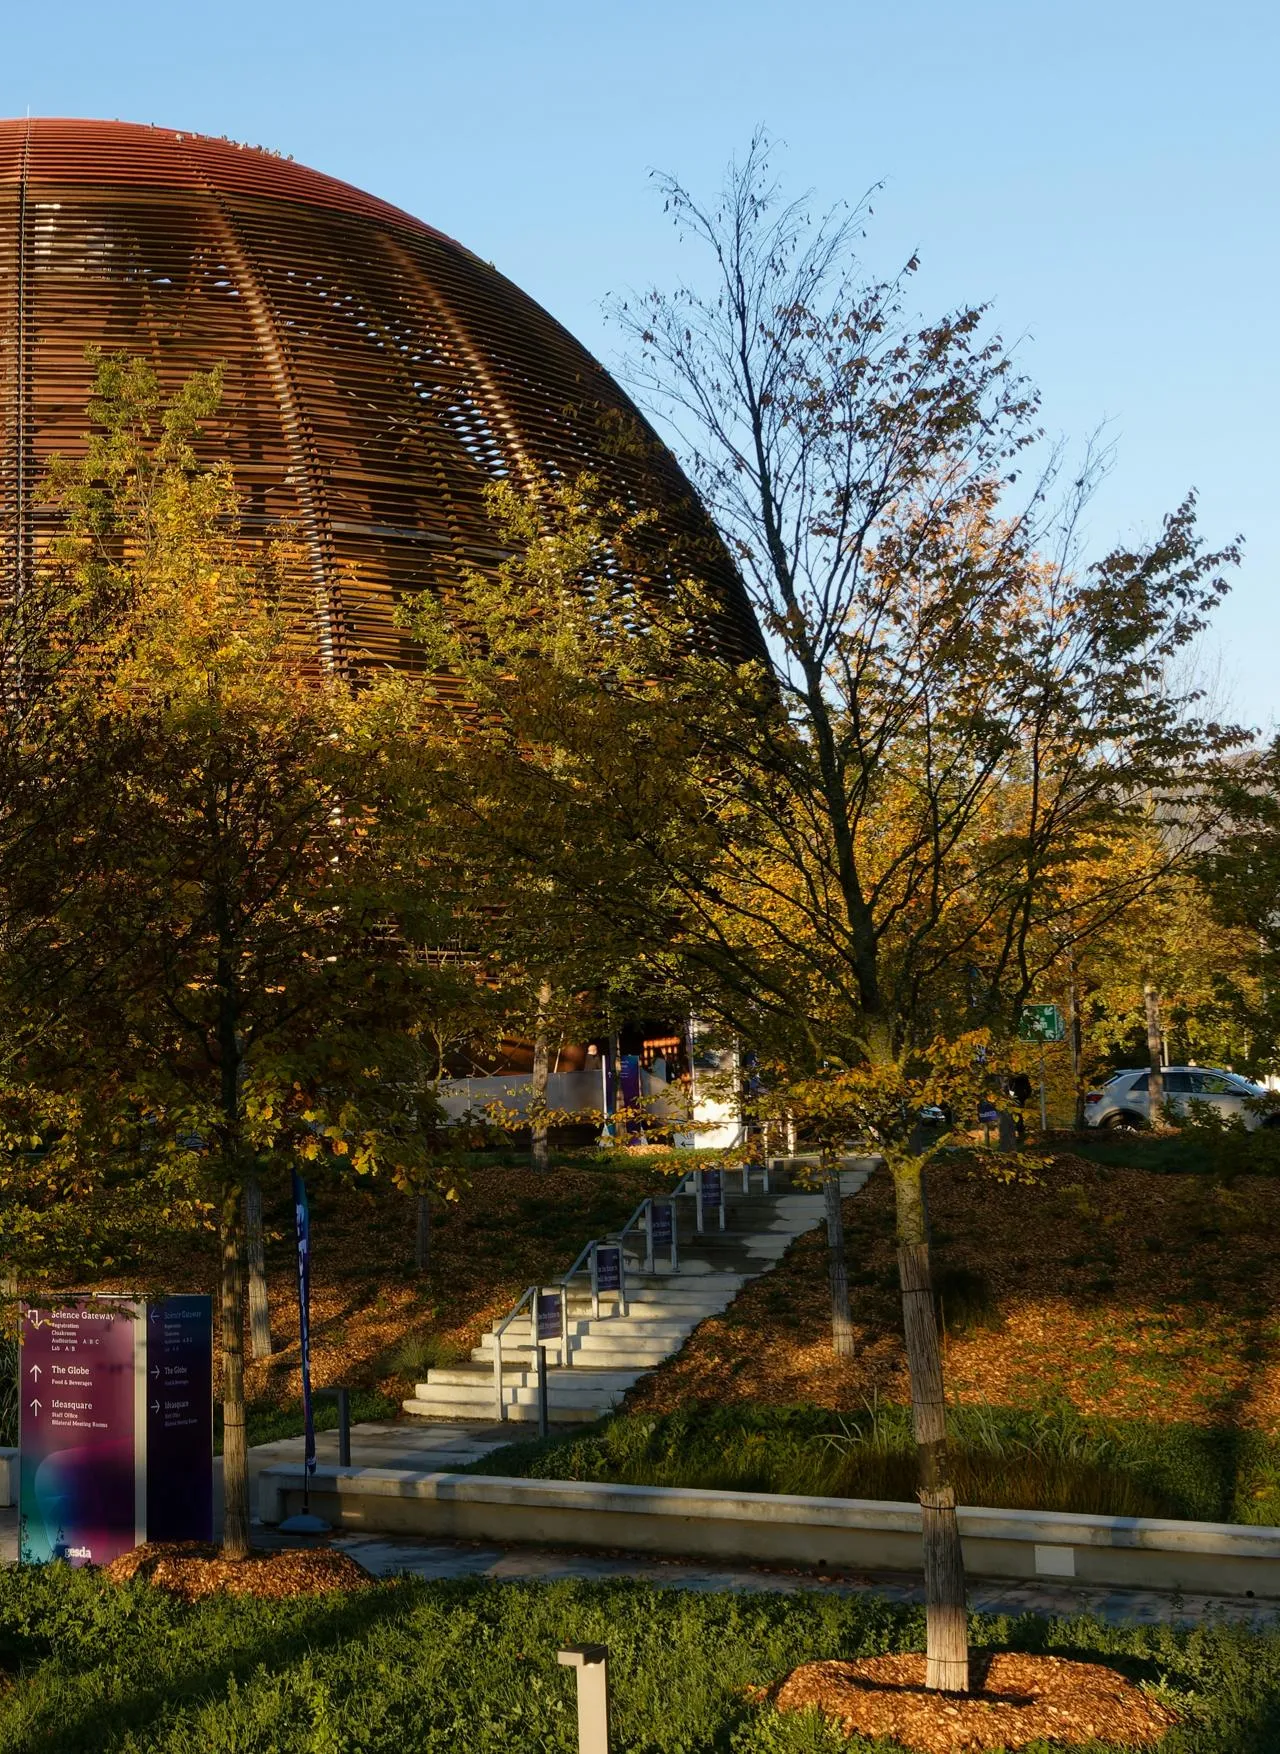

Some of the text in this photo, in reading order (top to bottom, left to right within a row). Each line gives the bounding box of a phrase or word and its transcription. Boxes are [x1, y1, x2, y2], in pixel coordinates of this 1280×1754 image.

[51, 1311, 116, 1321] Science Gateway
[51, 1365, 90, 1375] The Globe
[69, 1379, 93, 1387] Beverages
[51, 1399, 93, 1410] Ideasquare
[64, 1546, 92, 1559] gesda
